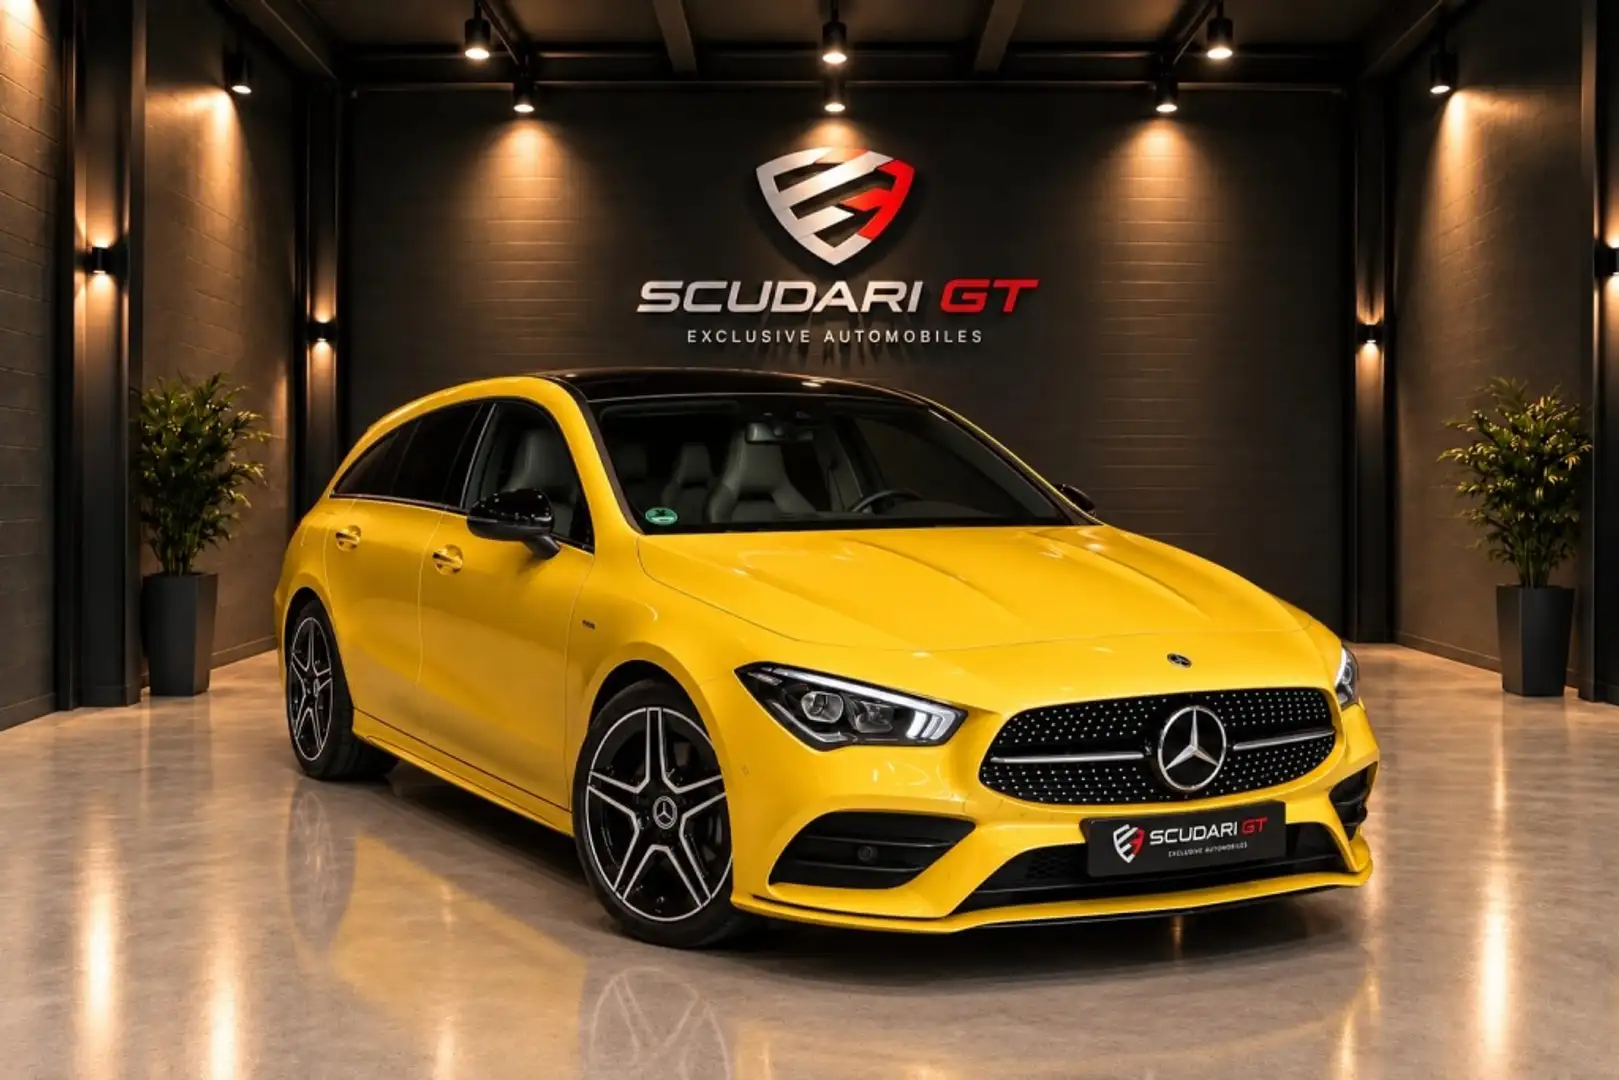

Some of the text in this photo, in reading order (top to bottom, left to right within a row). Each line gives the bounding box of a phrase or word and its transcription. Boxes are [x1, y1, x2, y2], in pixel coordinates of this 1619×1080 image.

[636, 279, 1039, 313] SCUDARI GT
[687, 330, 983, 343] EXCLUSIVE AUTOMOBILES
[1149, 817, 1268, 846] SCUDARI GT
